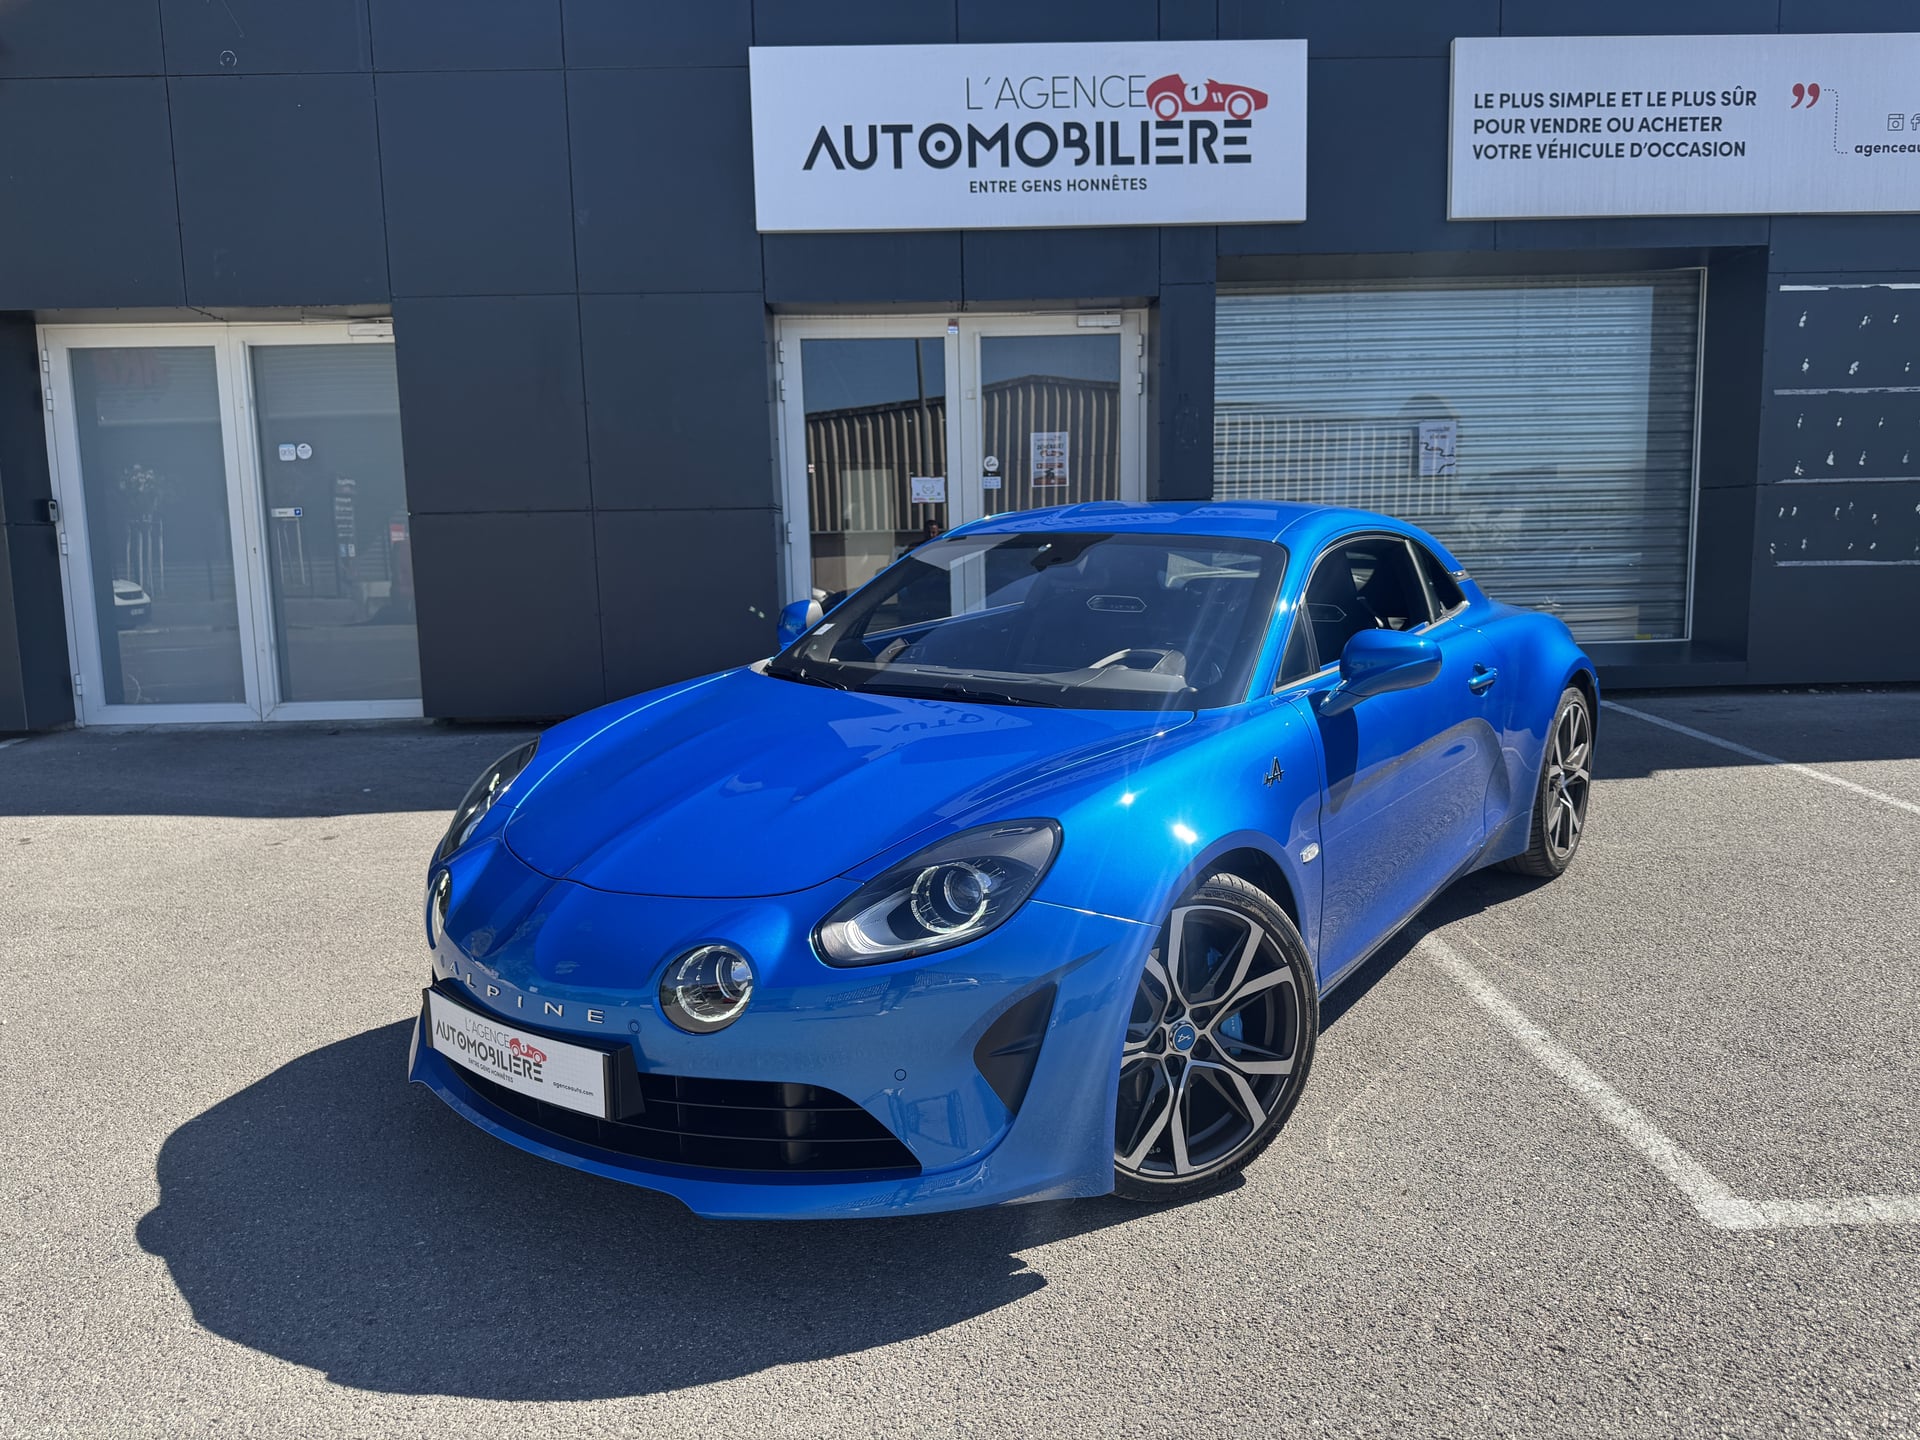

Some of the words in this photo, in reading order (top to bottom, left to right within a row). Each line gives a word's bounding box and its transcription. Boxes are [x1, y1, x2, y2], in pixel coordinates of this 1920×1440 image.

[965, 74, 1146, 110] L'AGENCE
[1474, 93, 1494, 109] LE
[1499, 92, 1544, 109] PLUS
[1549, 91, 1616, 108] SIMPLE
[1621, 91, 1643, 107] ET
[1647, 91, 1667, 107] LE
[1671, 90, 1717, 107] PLUS
[1721, 85, 1757, 106] SÛR
[1473, 118, 1526, 134] POUR
[1530, 117, 1602, 134] VENDRE
[1606, 117, 1635, 133] OU
[1638, 116, 1722, 133] ACHETER
[1473, 144, 1532, 160] VOTRE
[1536, 138, 1625, 159] VÉHICULE
[1630, 141, 1746, 158] D'OCCASION
[969, 180, 1017, 193] ENTRE
[1021, 178, 1063, 192] GENS
[1066, 174, 1148, 192] HONNÊTES
[449, 960, 605, 1025] ALPINE
